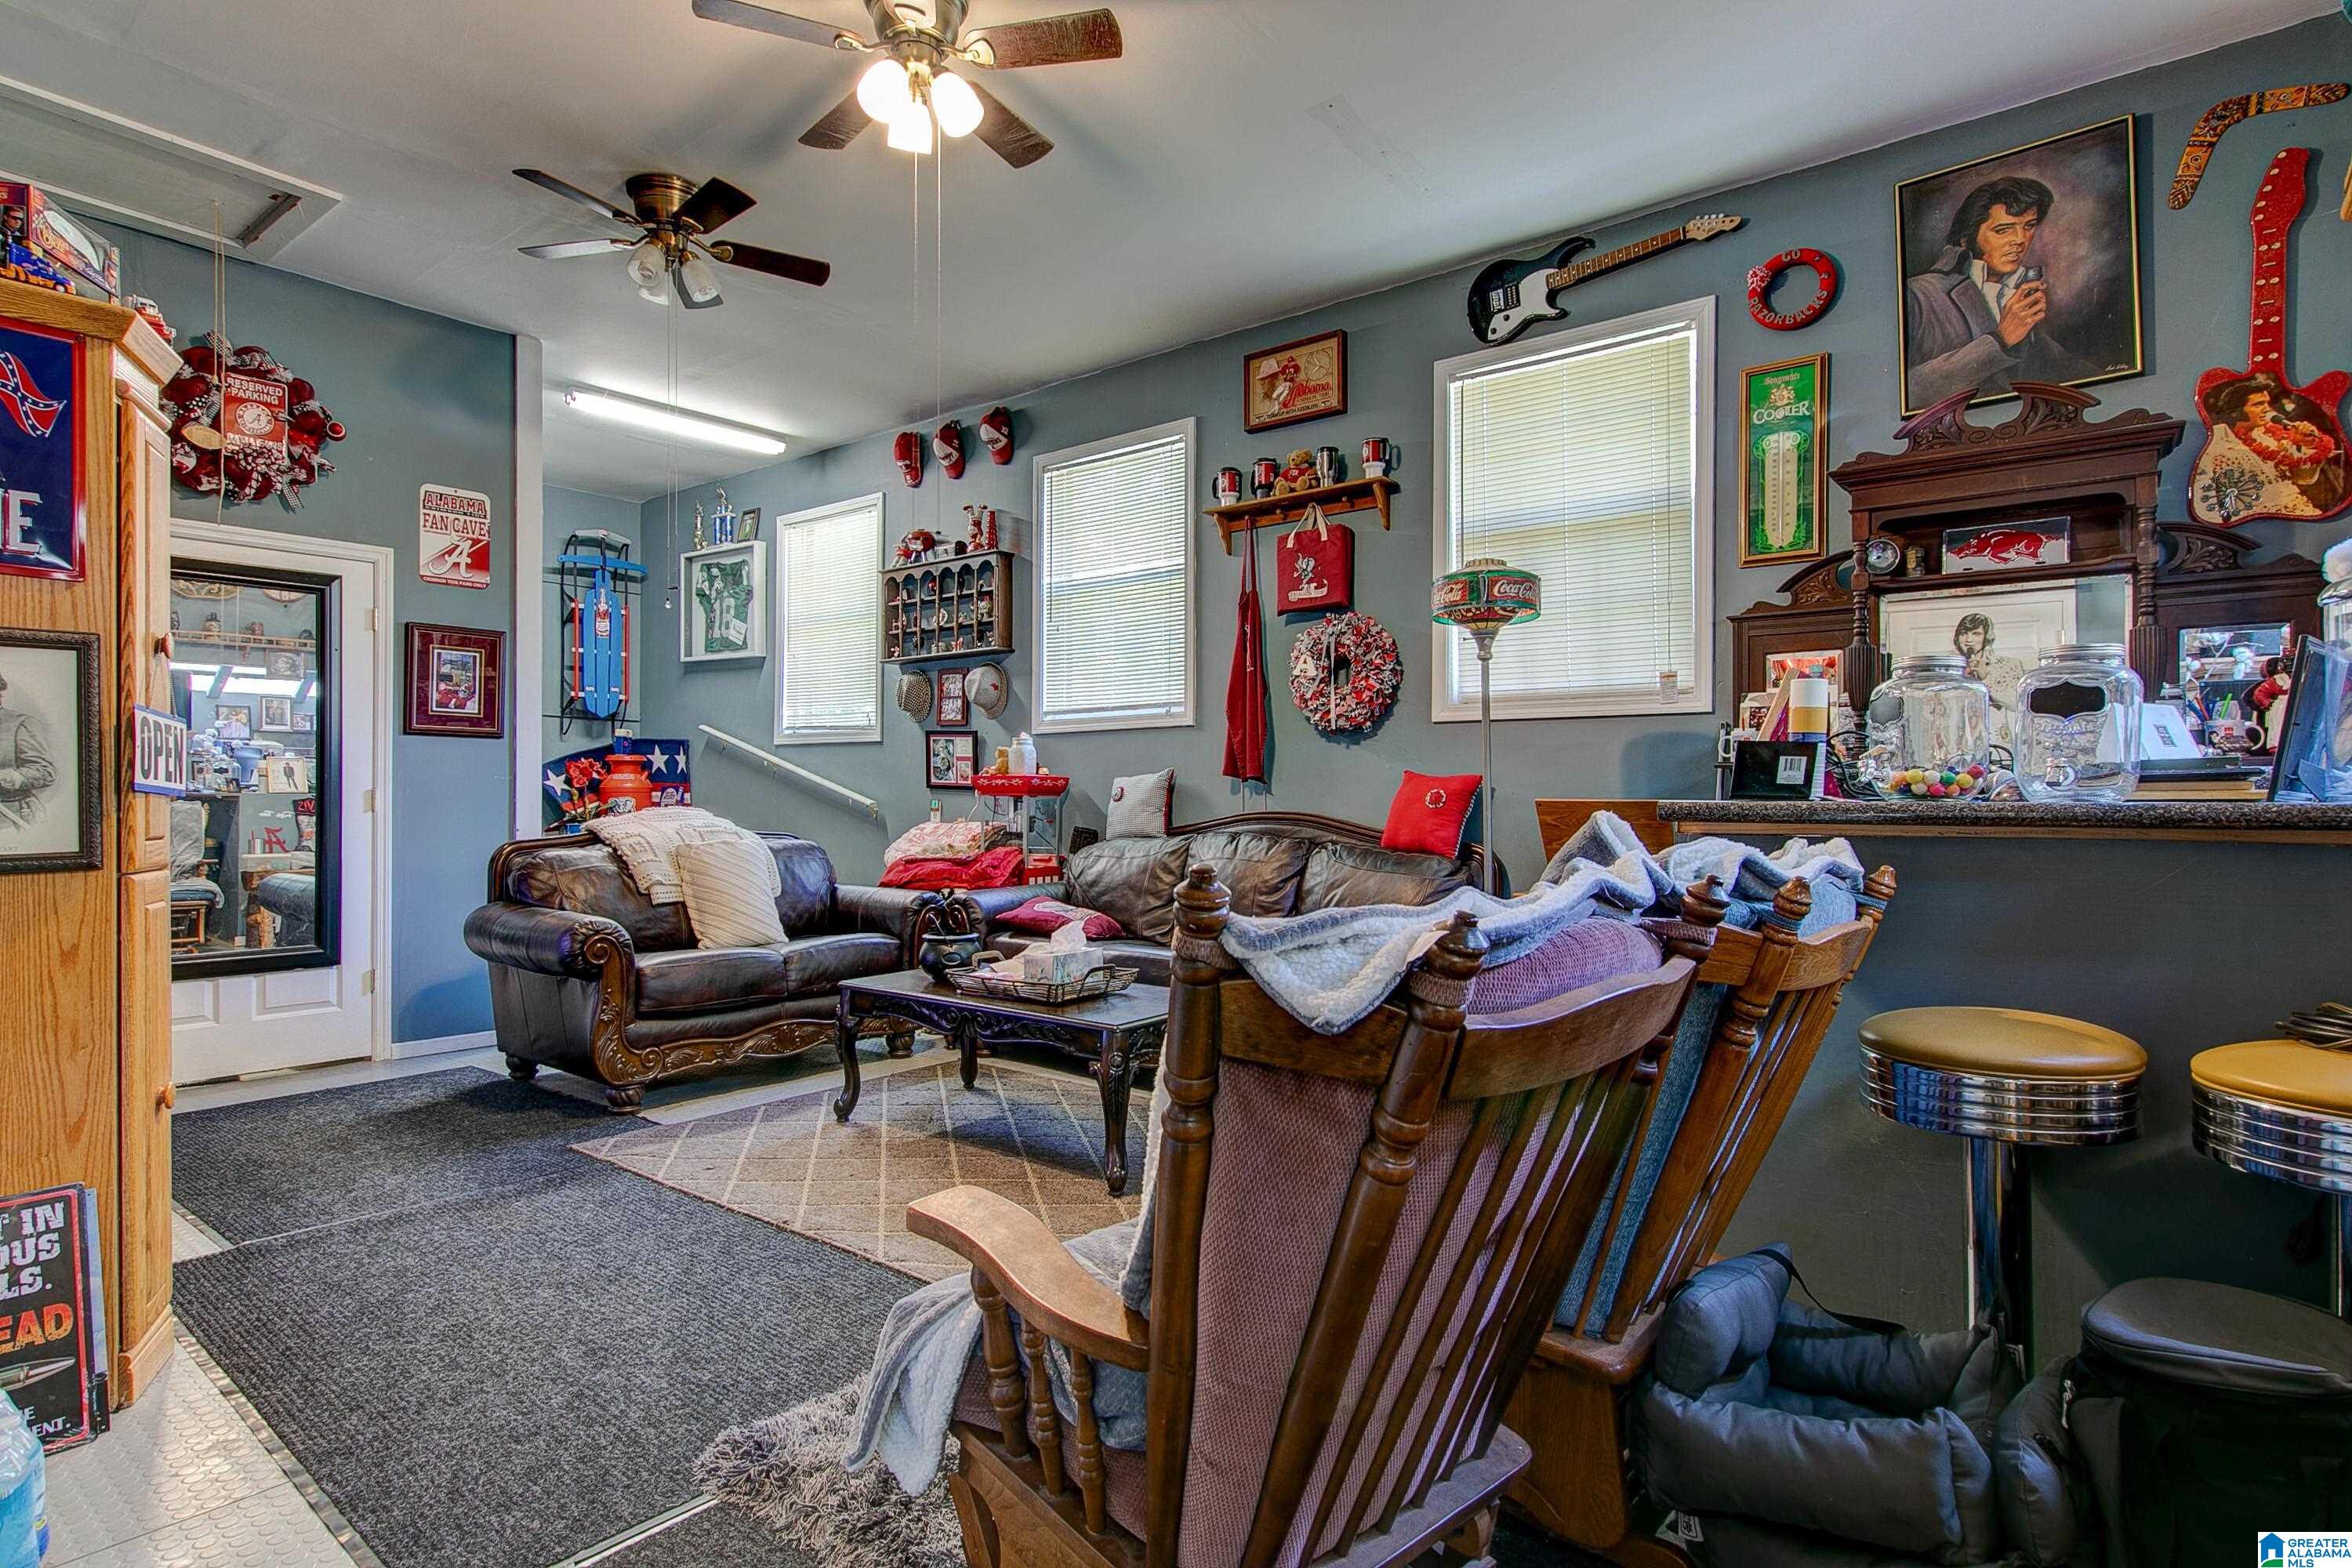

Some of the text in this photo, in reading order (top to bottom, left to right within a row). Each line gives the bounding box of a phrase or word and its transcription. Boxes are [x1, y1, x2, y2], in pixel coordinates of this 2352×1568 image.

[1781, 249, 1801, 262] GO
[1751, 289, 1828, 325] RAZORBACKS
[226, 377, 283, 397] RESERVED
[230, 387, 279, 405] PARKING
[1753, 401, 1811, 425] COOLER
[426, 492, 485, 515] ALABAMA
[0, 488, 43, 556] E
[423, 512, 449, 532] FAN
[452, 517, 486, 537] CAVE
[140, 716, 184, 785] OPEN
[20, 1200, 64, 1236] IN
